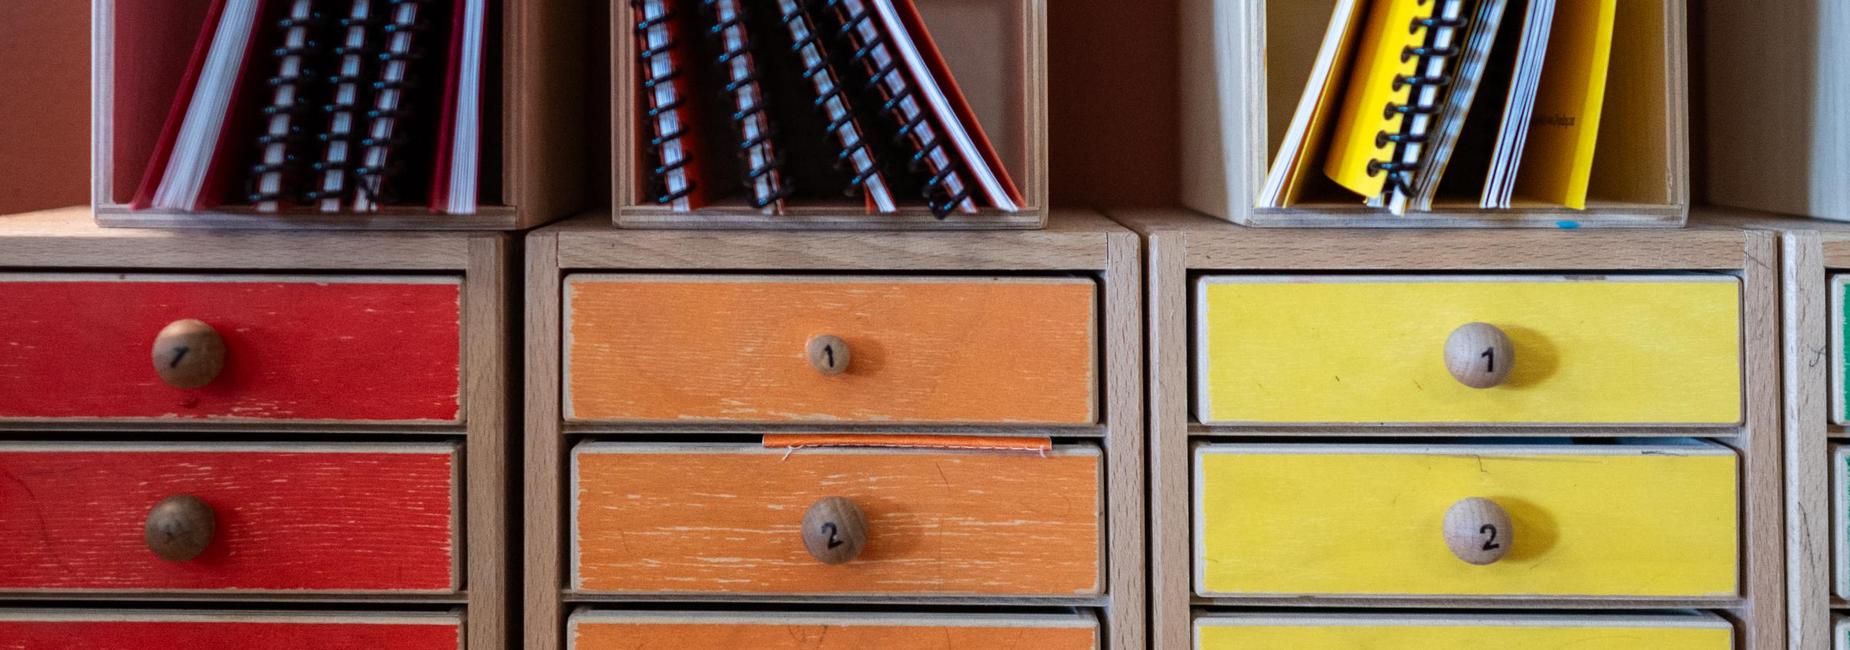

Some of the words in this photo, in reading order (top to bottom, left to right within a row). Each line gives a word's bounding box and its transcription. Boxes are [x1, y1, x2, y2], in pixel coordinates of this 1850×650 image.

[824, 344, 834, 368] 1
[1481, 347, 1494, 372] 1
[821, 522, 844, 550] 2
[1479, 524, 1500, 551] 2
